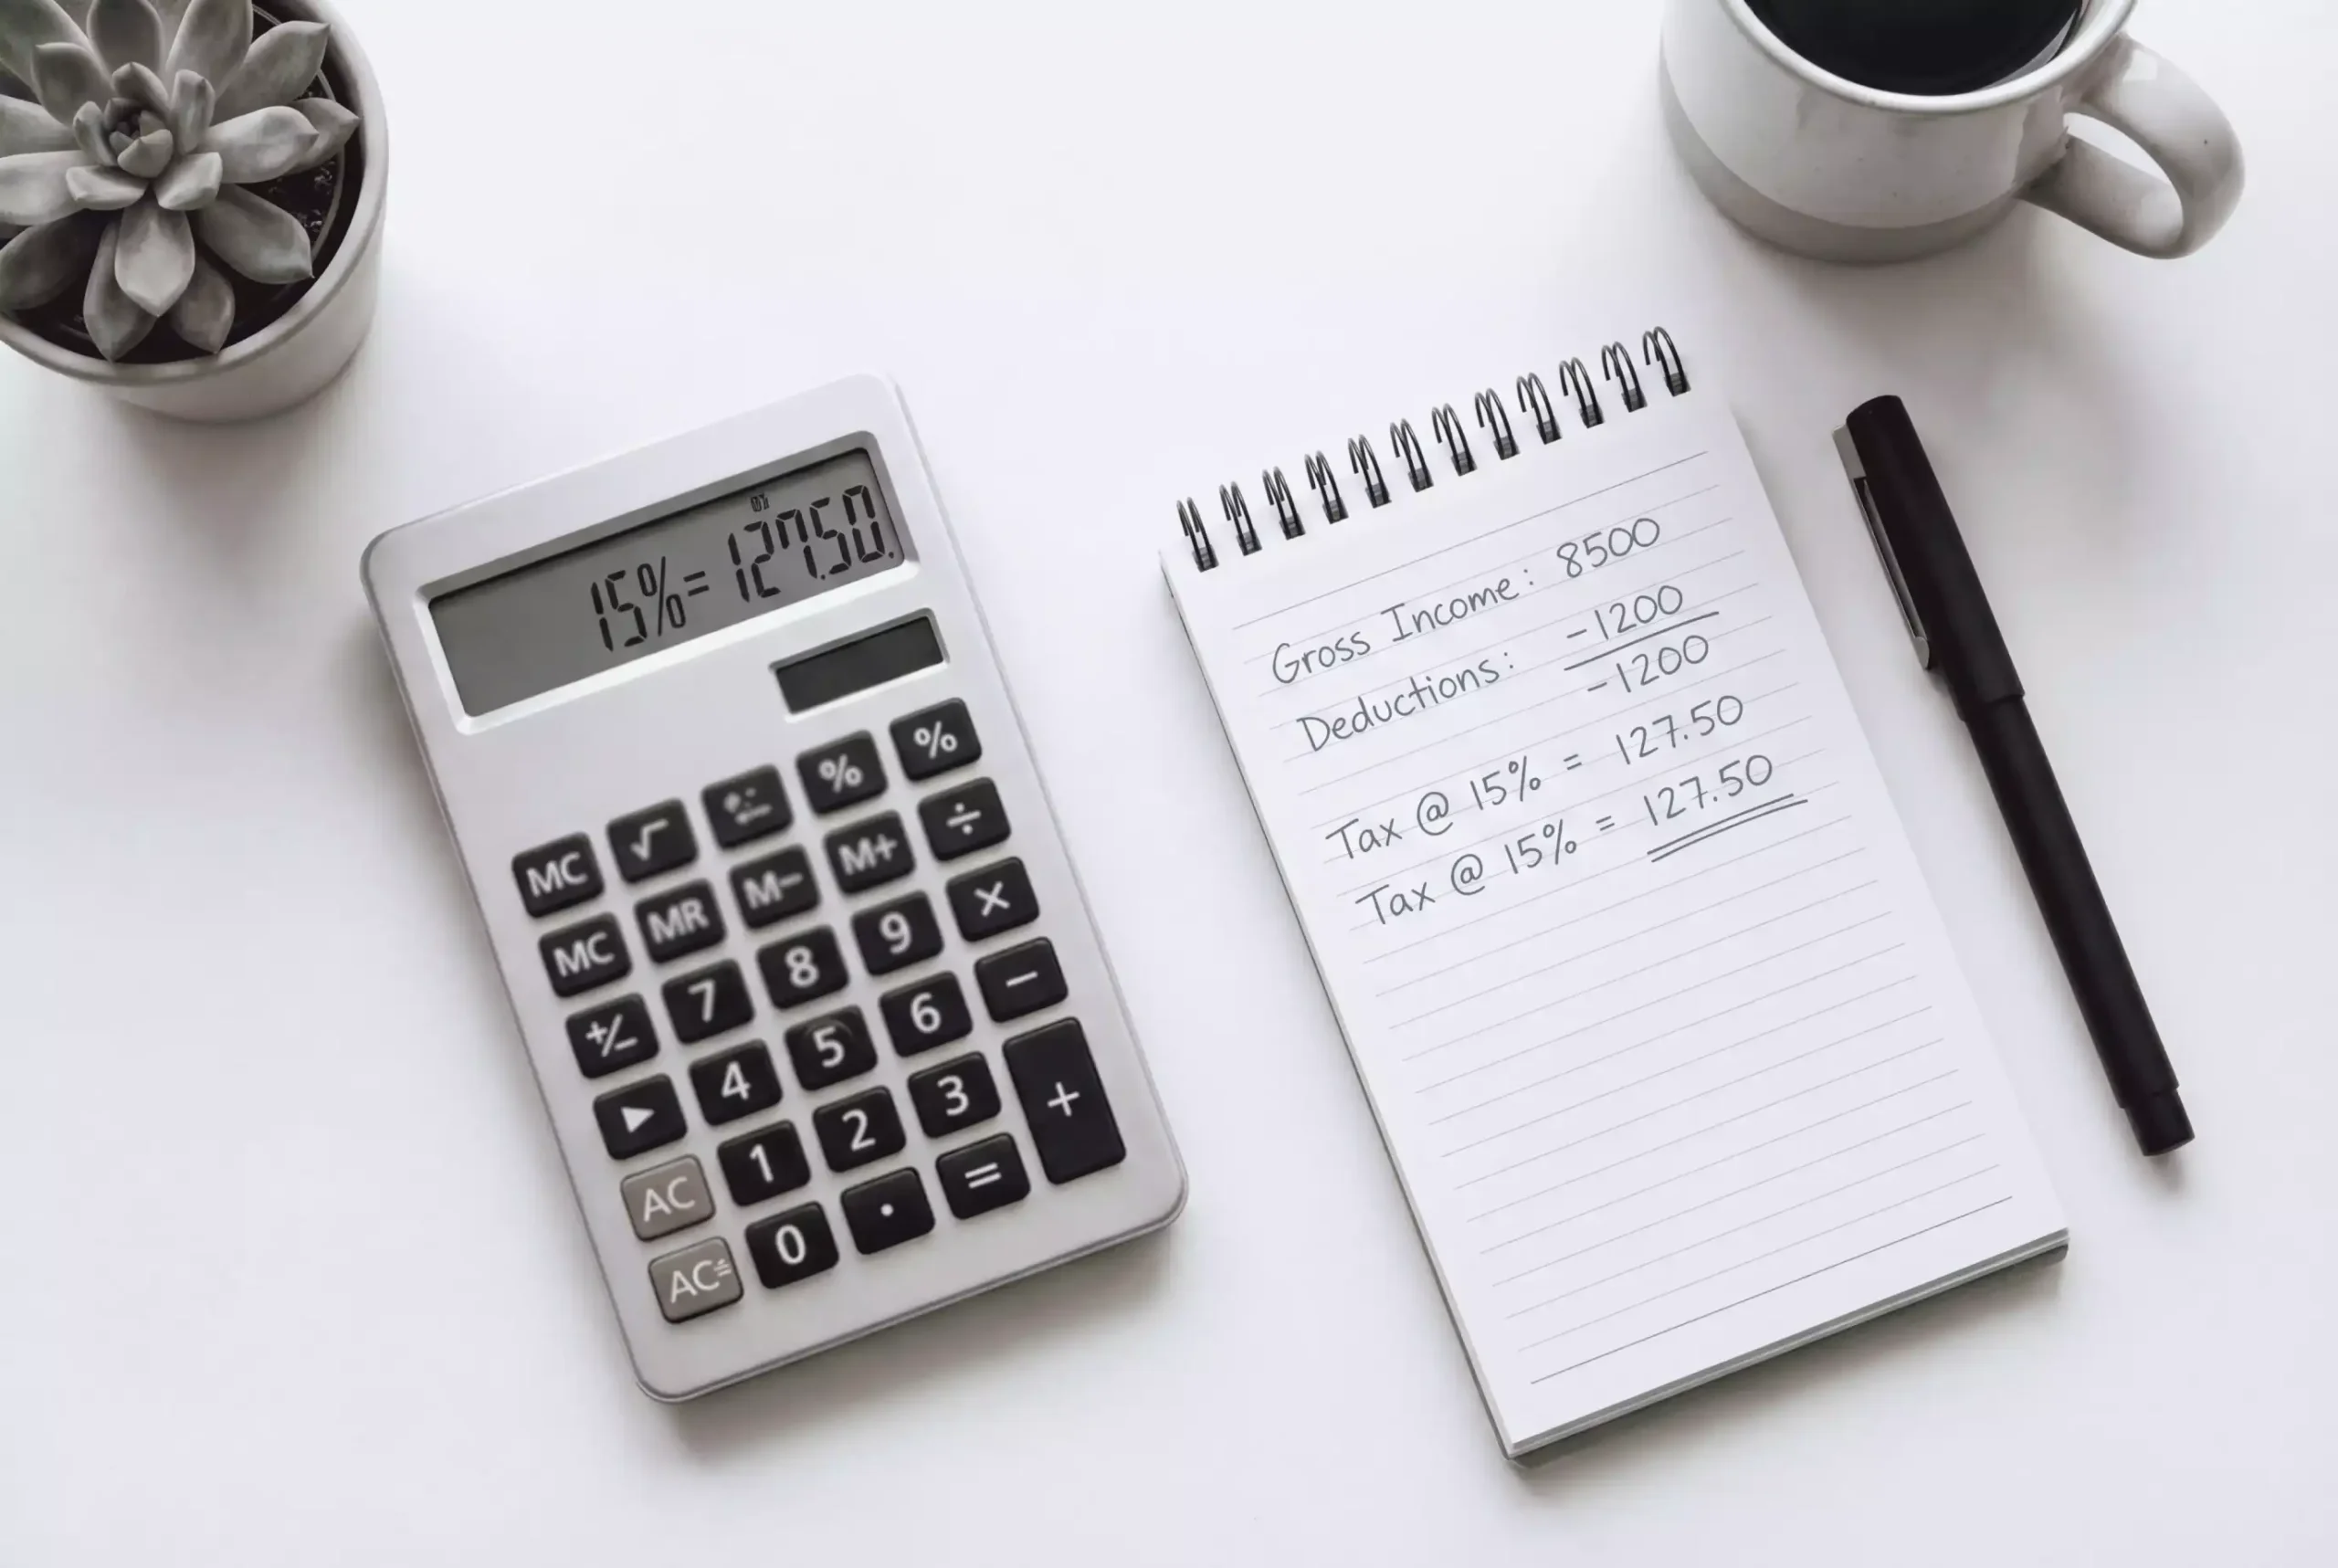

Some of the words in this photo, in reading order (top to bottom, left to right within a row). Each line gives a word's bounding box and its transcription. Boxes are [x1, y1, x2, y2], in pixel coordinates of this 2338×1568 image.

[1271, 630, 1371, 684] Gross
[1381, 568, 1535, 642] Income:
[1556, 518, 1660, 579] 8500
[1297, 651, 1515, 752] Deductions:
[1567, 584, 1684, 640] -1200
[1588, 634, 1710, 694] -1200
[913, 721, 958, 758] %
[818, 754, 862, 792] %
[1326, 817, 1404, 859] Tax
[1416, 791, 1453, 835] @
[1469, 755, 1542, 811] 15%
[1564, 753, 1583, 771] =
[1616, 695, 1743, 765] 127.50
[838, 835, 896, 874] M+
[1355, 882, 1436, 924] Tax
[1451, 853, 1486, 895] @
[1504, 818, 1578, 874] 15%
[1596, 815, 1615, 831] =
[1644, 754, 1774, 826] 127.50
[526, 852, 586, 896] MC
[743, 871, 802, 909] M-
[648, 899, 709, 942] MR
[879, 912, 911, 953] 9
[553, 932, 614, 976] MC
[785, 946, 818, 987] 8
[689, 979, 715, 1022] 7
[911, 993, 941, 1033] 6
[813, 1026, 844, 1068] 5
[721, 1061, 750, 1100] 4
[937, 1075, 969, 1116] 3
[842, 1109, 876, 1151] 2
[750, 1144, 774, 1182] 1
[642, 1176, 696, 1222] AC
[775, 1225, 806, 1265] 0
